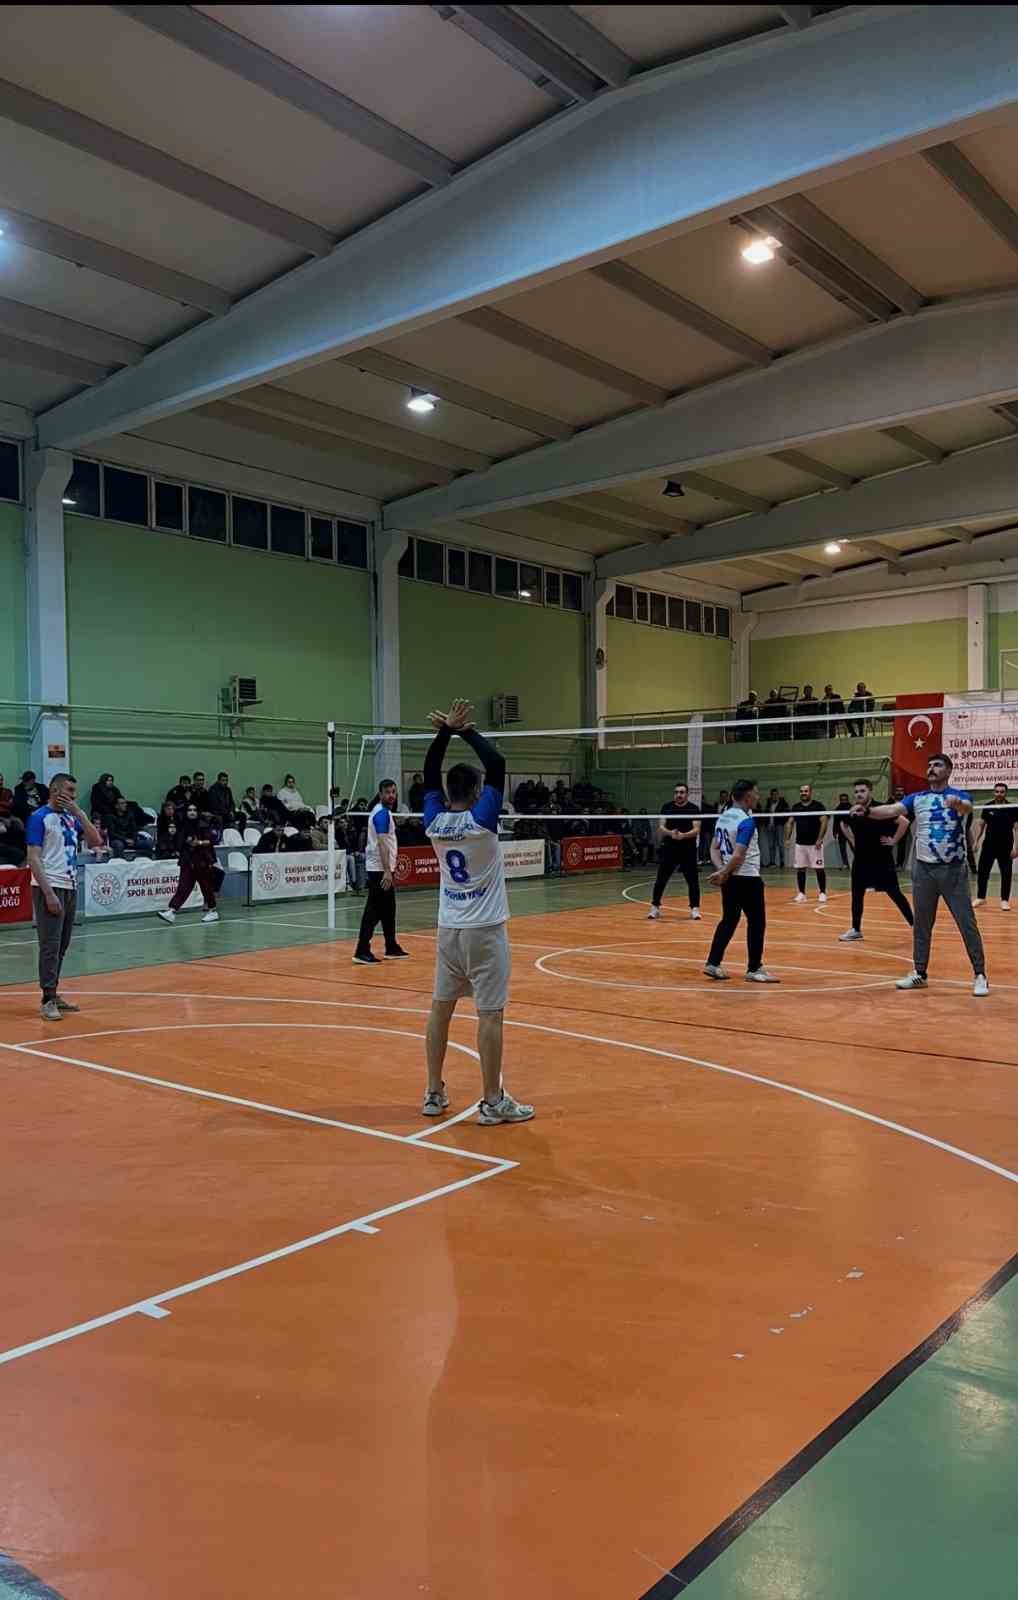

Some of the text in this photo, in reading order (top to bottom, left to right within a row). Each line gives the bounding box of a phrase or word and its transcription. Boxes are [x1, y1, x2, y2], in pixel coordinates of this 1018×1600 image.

[950, 738, 967, 748] TÜM
[953, 761, 995, 771] AŞARILAR
[446, 849, 470, 883] 8
[10, 886, 20, 895] VE
[127, 888, 146, 898] SPOR
